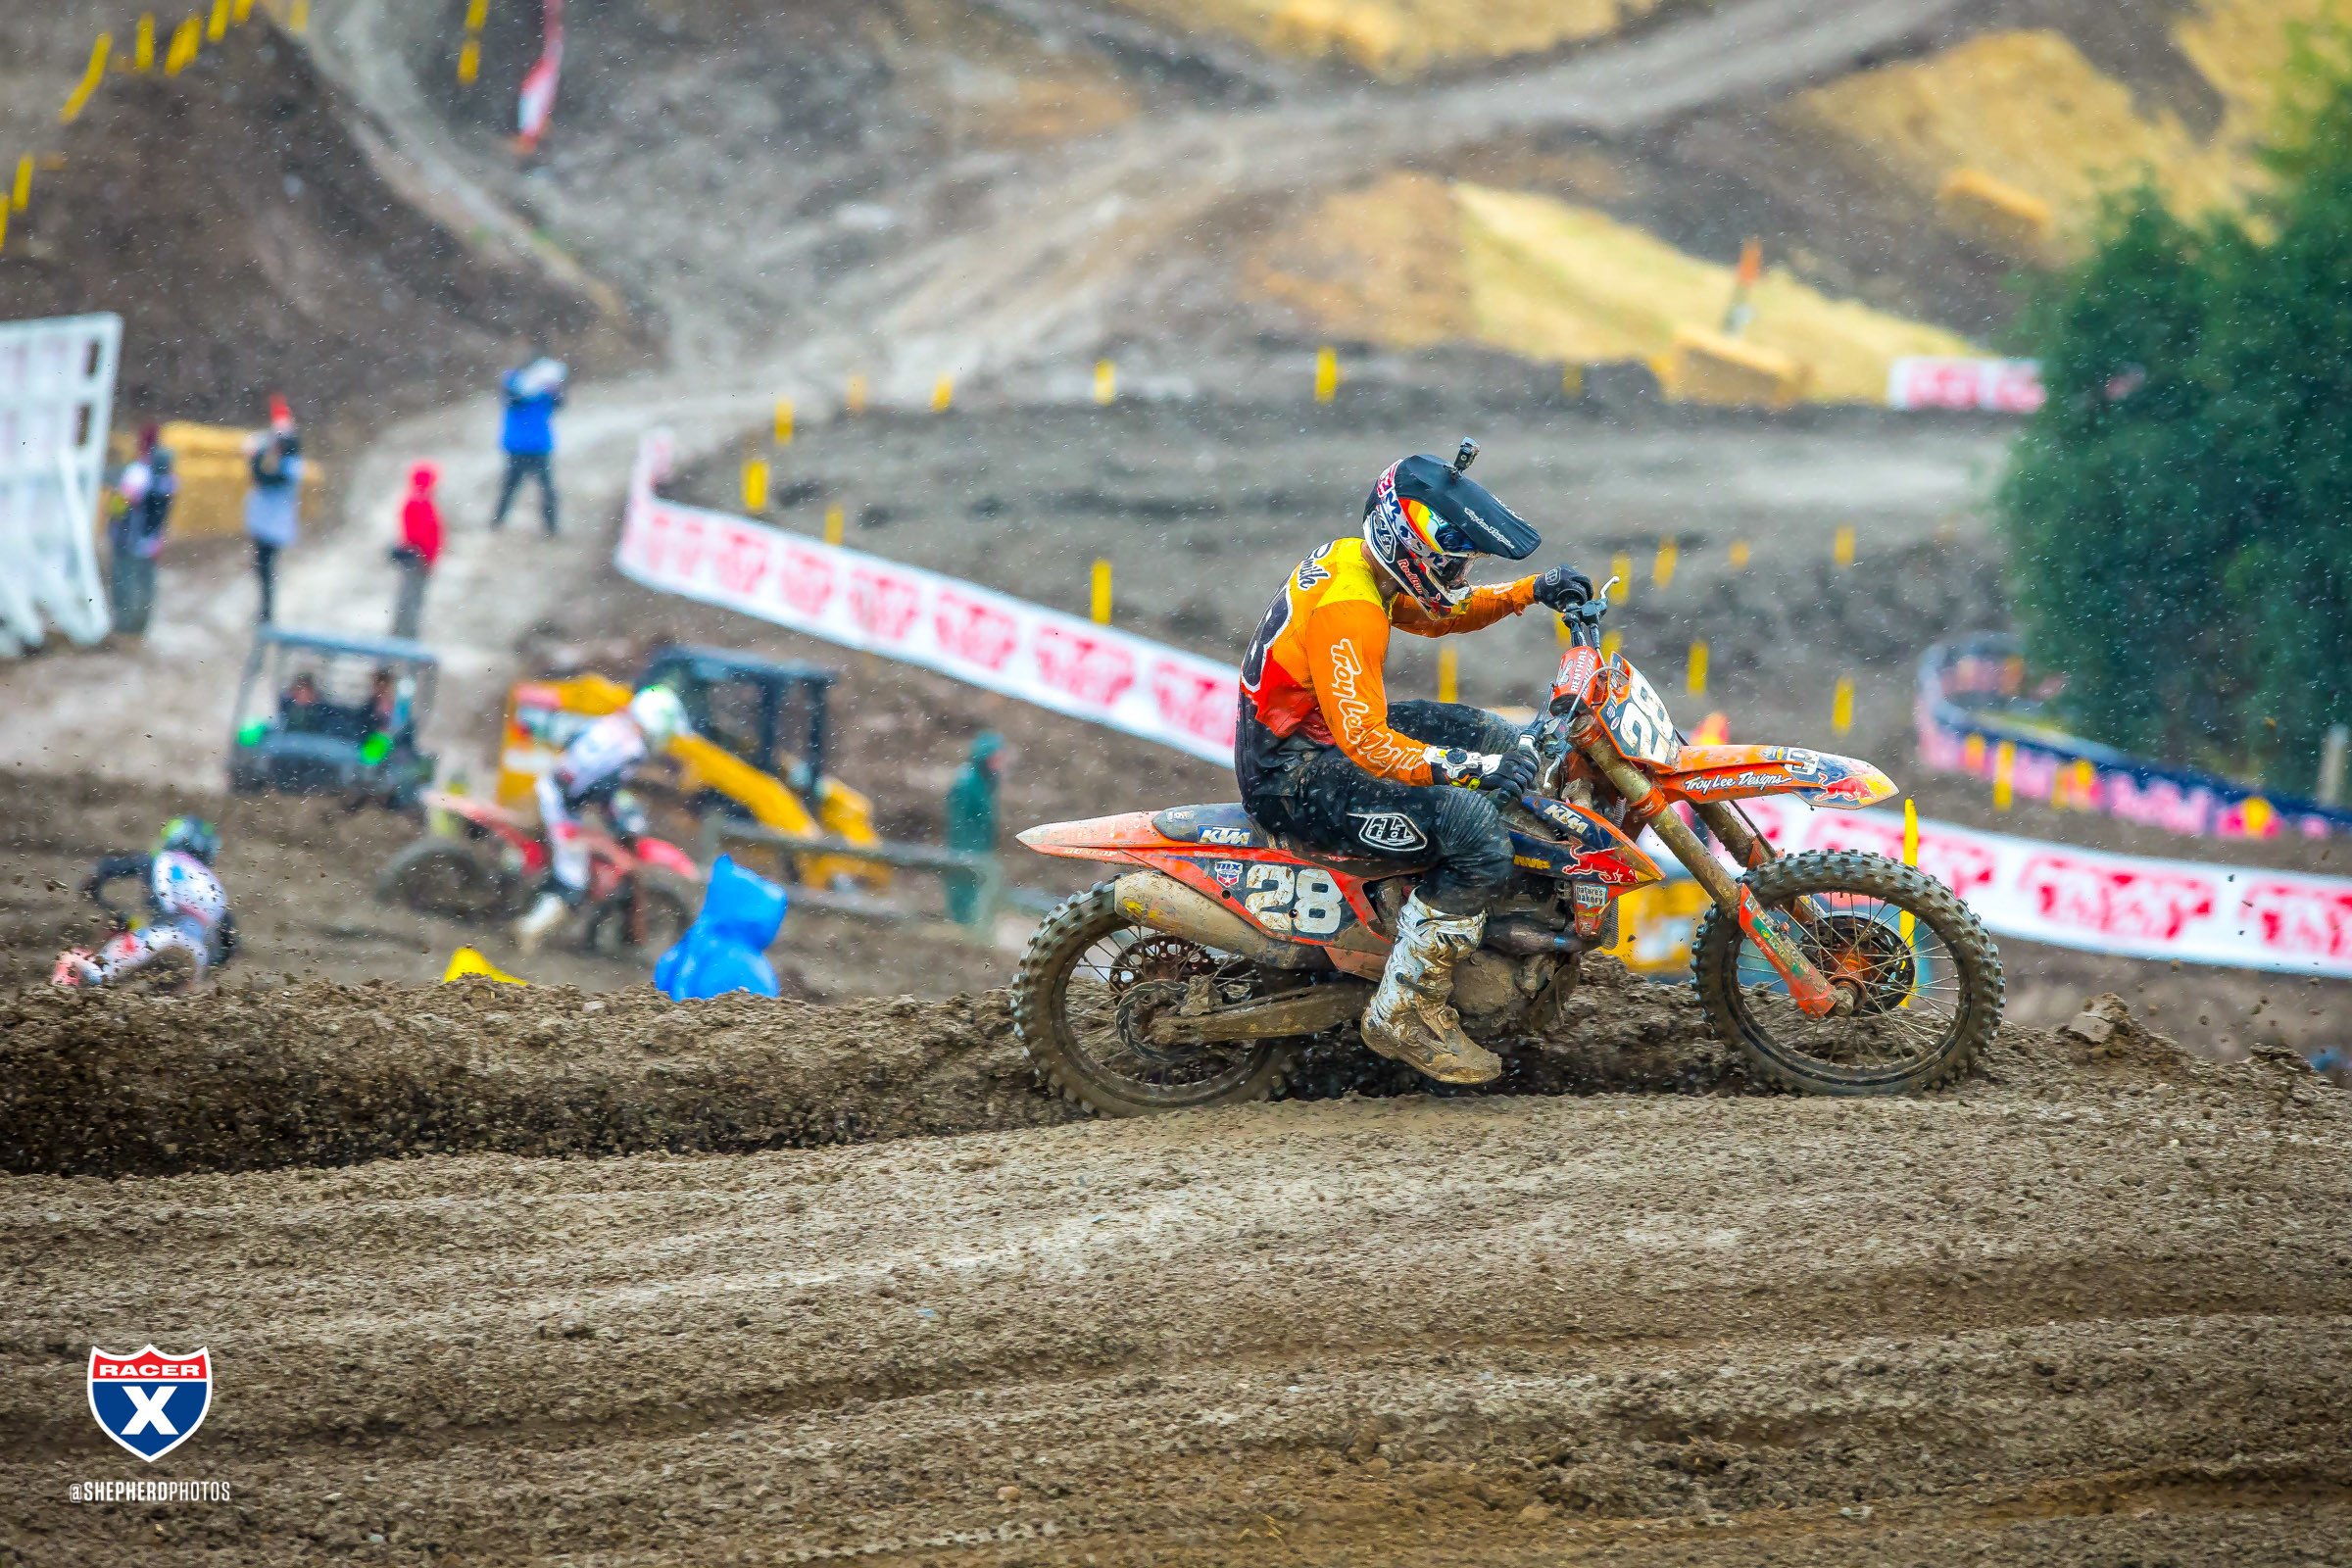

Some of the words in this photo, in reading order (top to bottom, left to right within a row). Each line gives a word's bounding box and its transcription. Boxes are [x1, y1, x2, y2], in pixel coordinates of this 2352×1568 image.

[1330, 638, 1362, 700] Troy
[1570, 649, 1588, 692] RENTHAL
[1620, 669, 1674, 764] 28
[1685, 776, 1710, 796] Troy
[1713, 775, 1736, 790] Lee
[1739, 772, 1792, 791] Designs
[1199, 827, 1251, 845] KTM
[1544, 804, 1589, 834] KTM
[1245, 863, 1343, 934] 28
[1576, 885, 1603, 897] nature's
